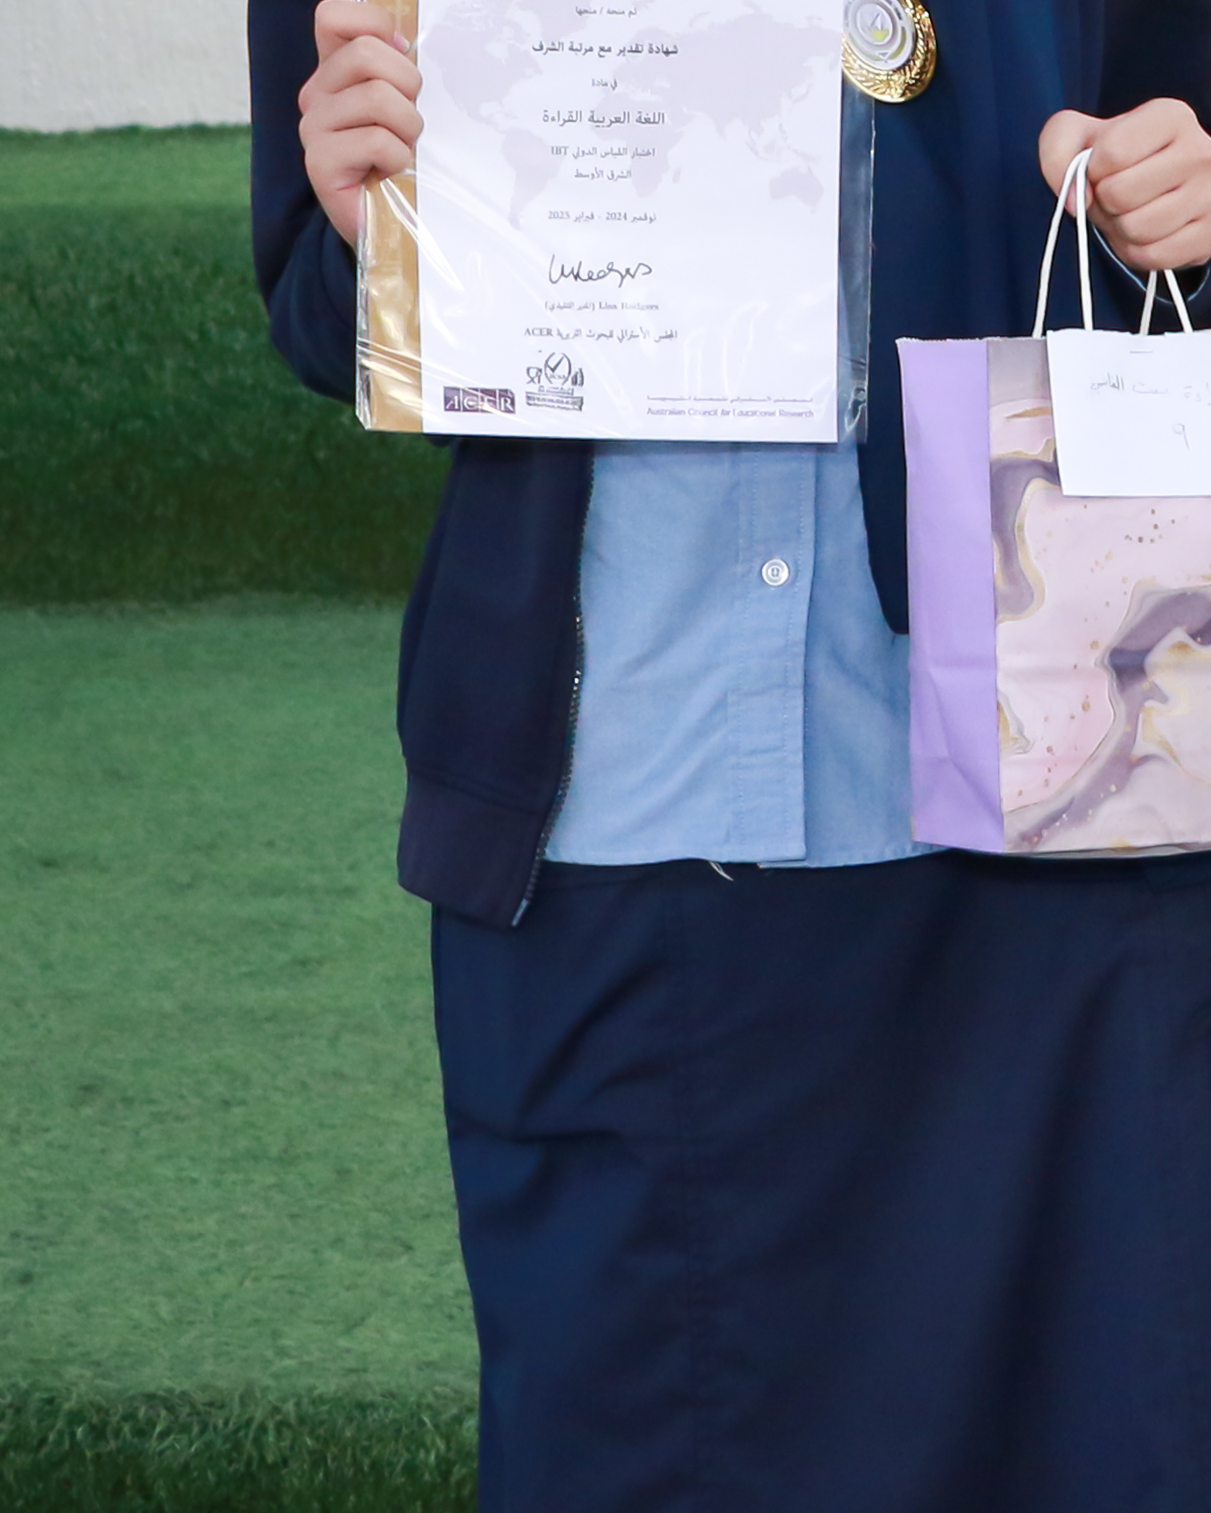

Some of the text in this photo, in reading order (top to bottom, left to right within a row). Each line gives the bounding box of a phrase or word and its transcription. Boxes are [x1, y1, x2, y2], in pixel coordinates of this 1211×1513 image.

[531, 40, 679, 59] شهادة تقدير مع مرتبة الشرف
[542, 109, 665, 129] اللغة العربية القراءة
[550, 145, 570, 157] IBT
[573, 166, 604, 181] الأوسط
[605, 211, 628, 222] 2024
[523, 327, 554, 338] ACER
